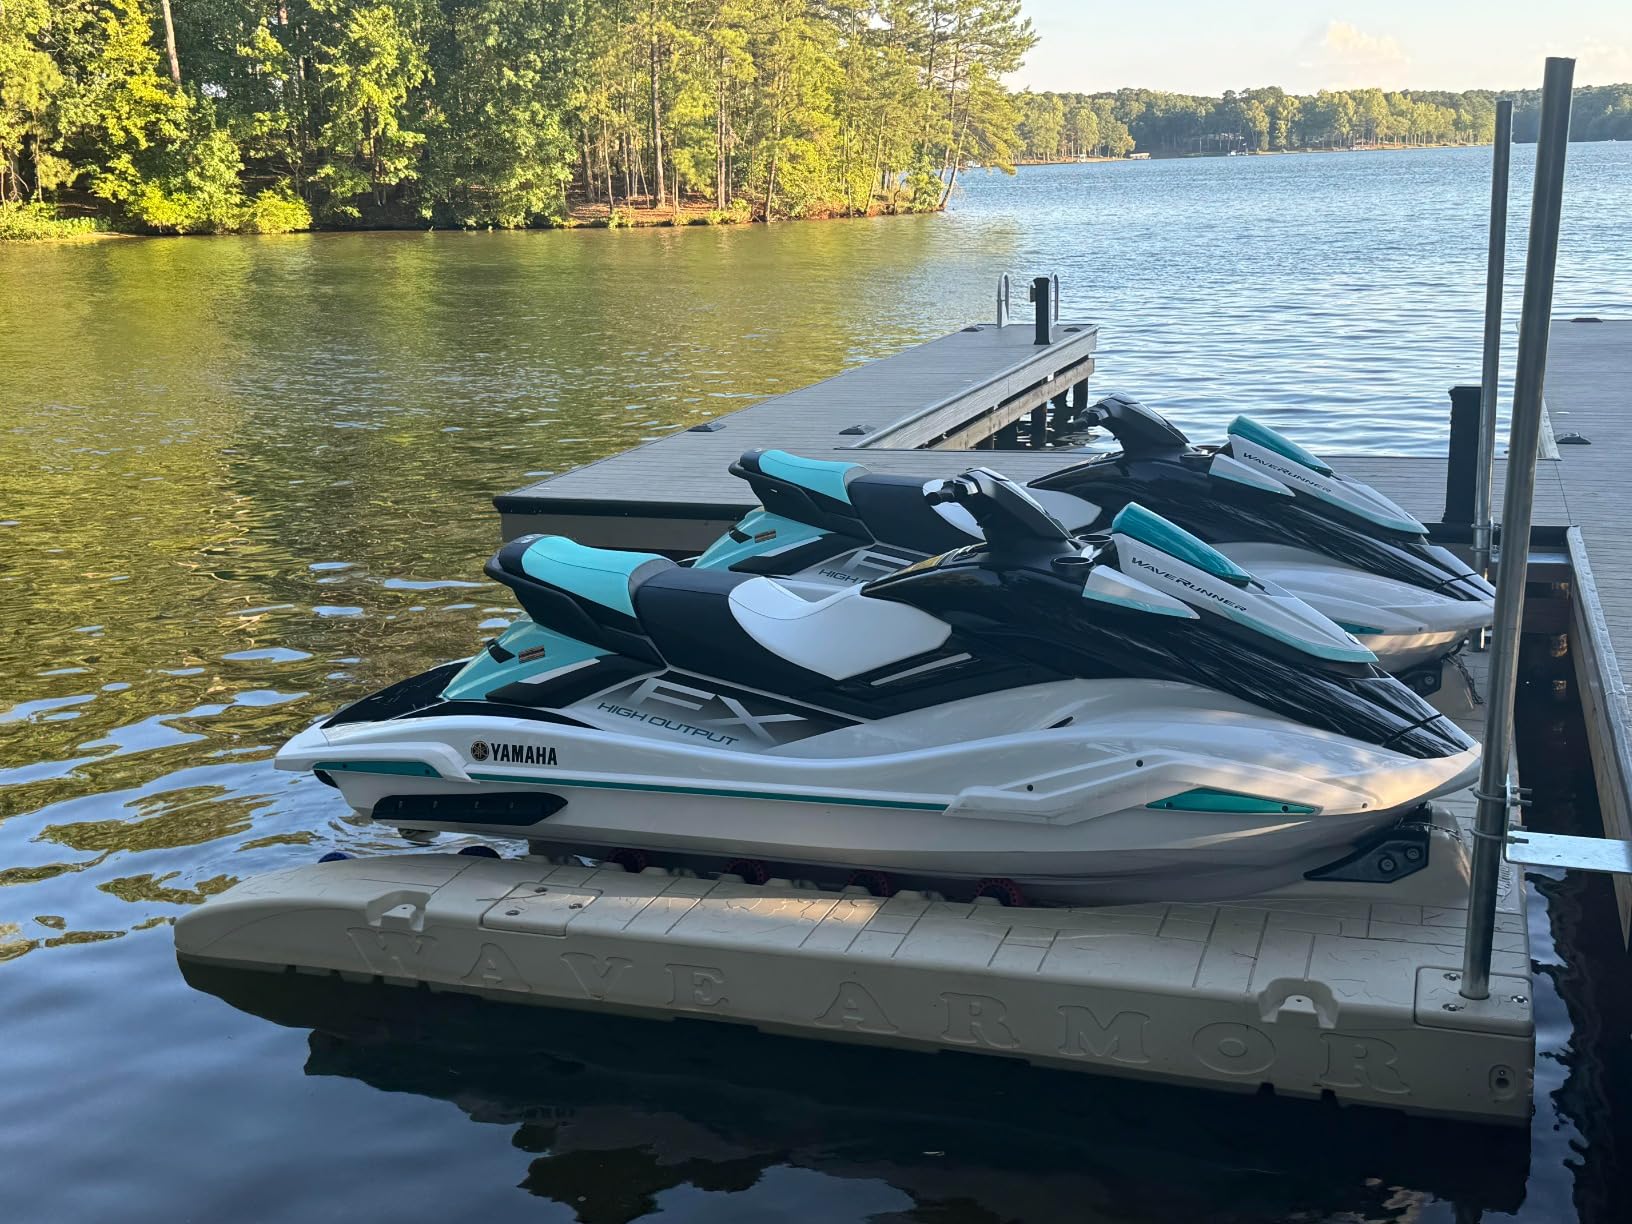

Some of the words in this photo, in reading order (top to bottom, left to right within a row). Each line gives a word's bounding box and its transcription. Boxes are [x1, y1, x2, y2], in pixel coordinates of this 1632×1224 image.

[818, 568, 860, 583] HIGH
[1132, 556, 1247, 612] WAVERUNNER
[597, 702, 648, 721] HIGH
[648, 716, 739, 746] OUTPUT
[490, 743, 558, 765] YAMAHA
[346, 927, 729, 1010] WAVE
[815, 981, 1411, 1095] ARMOR
